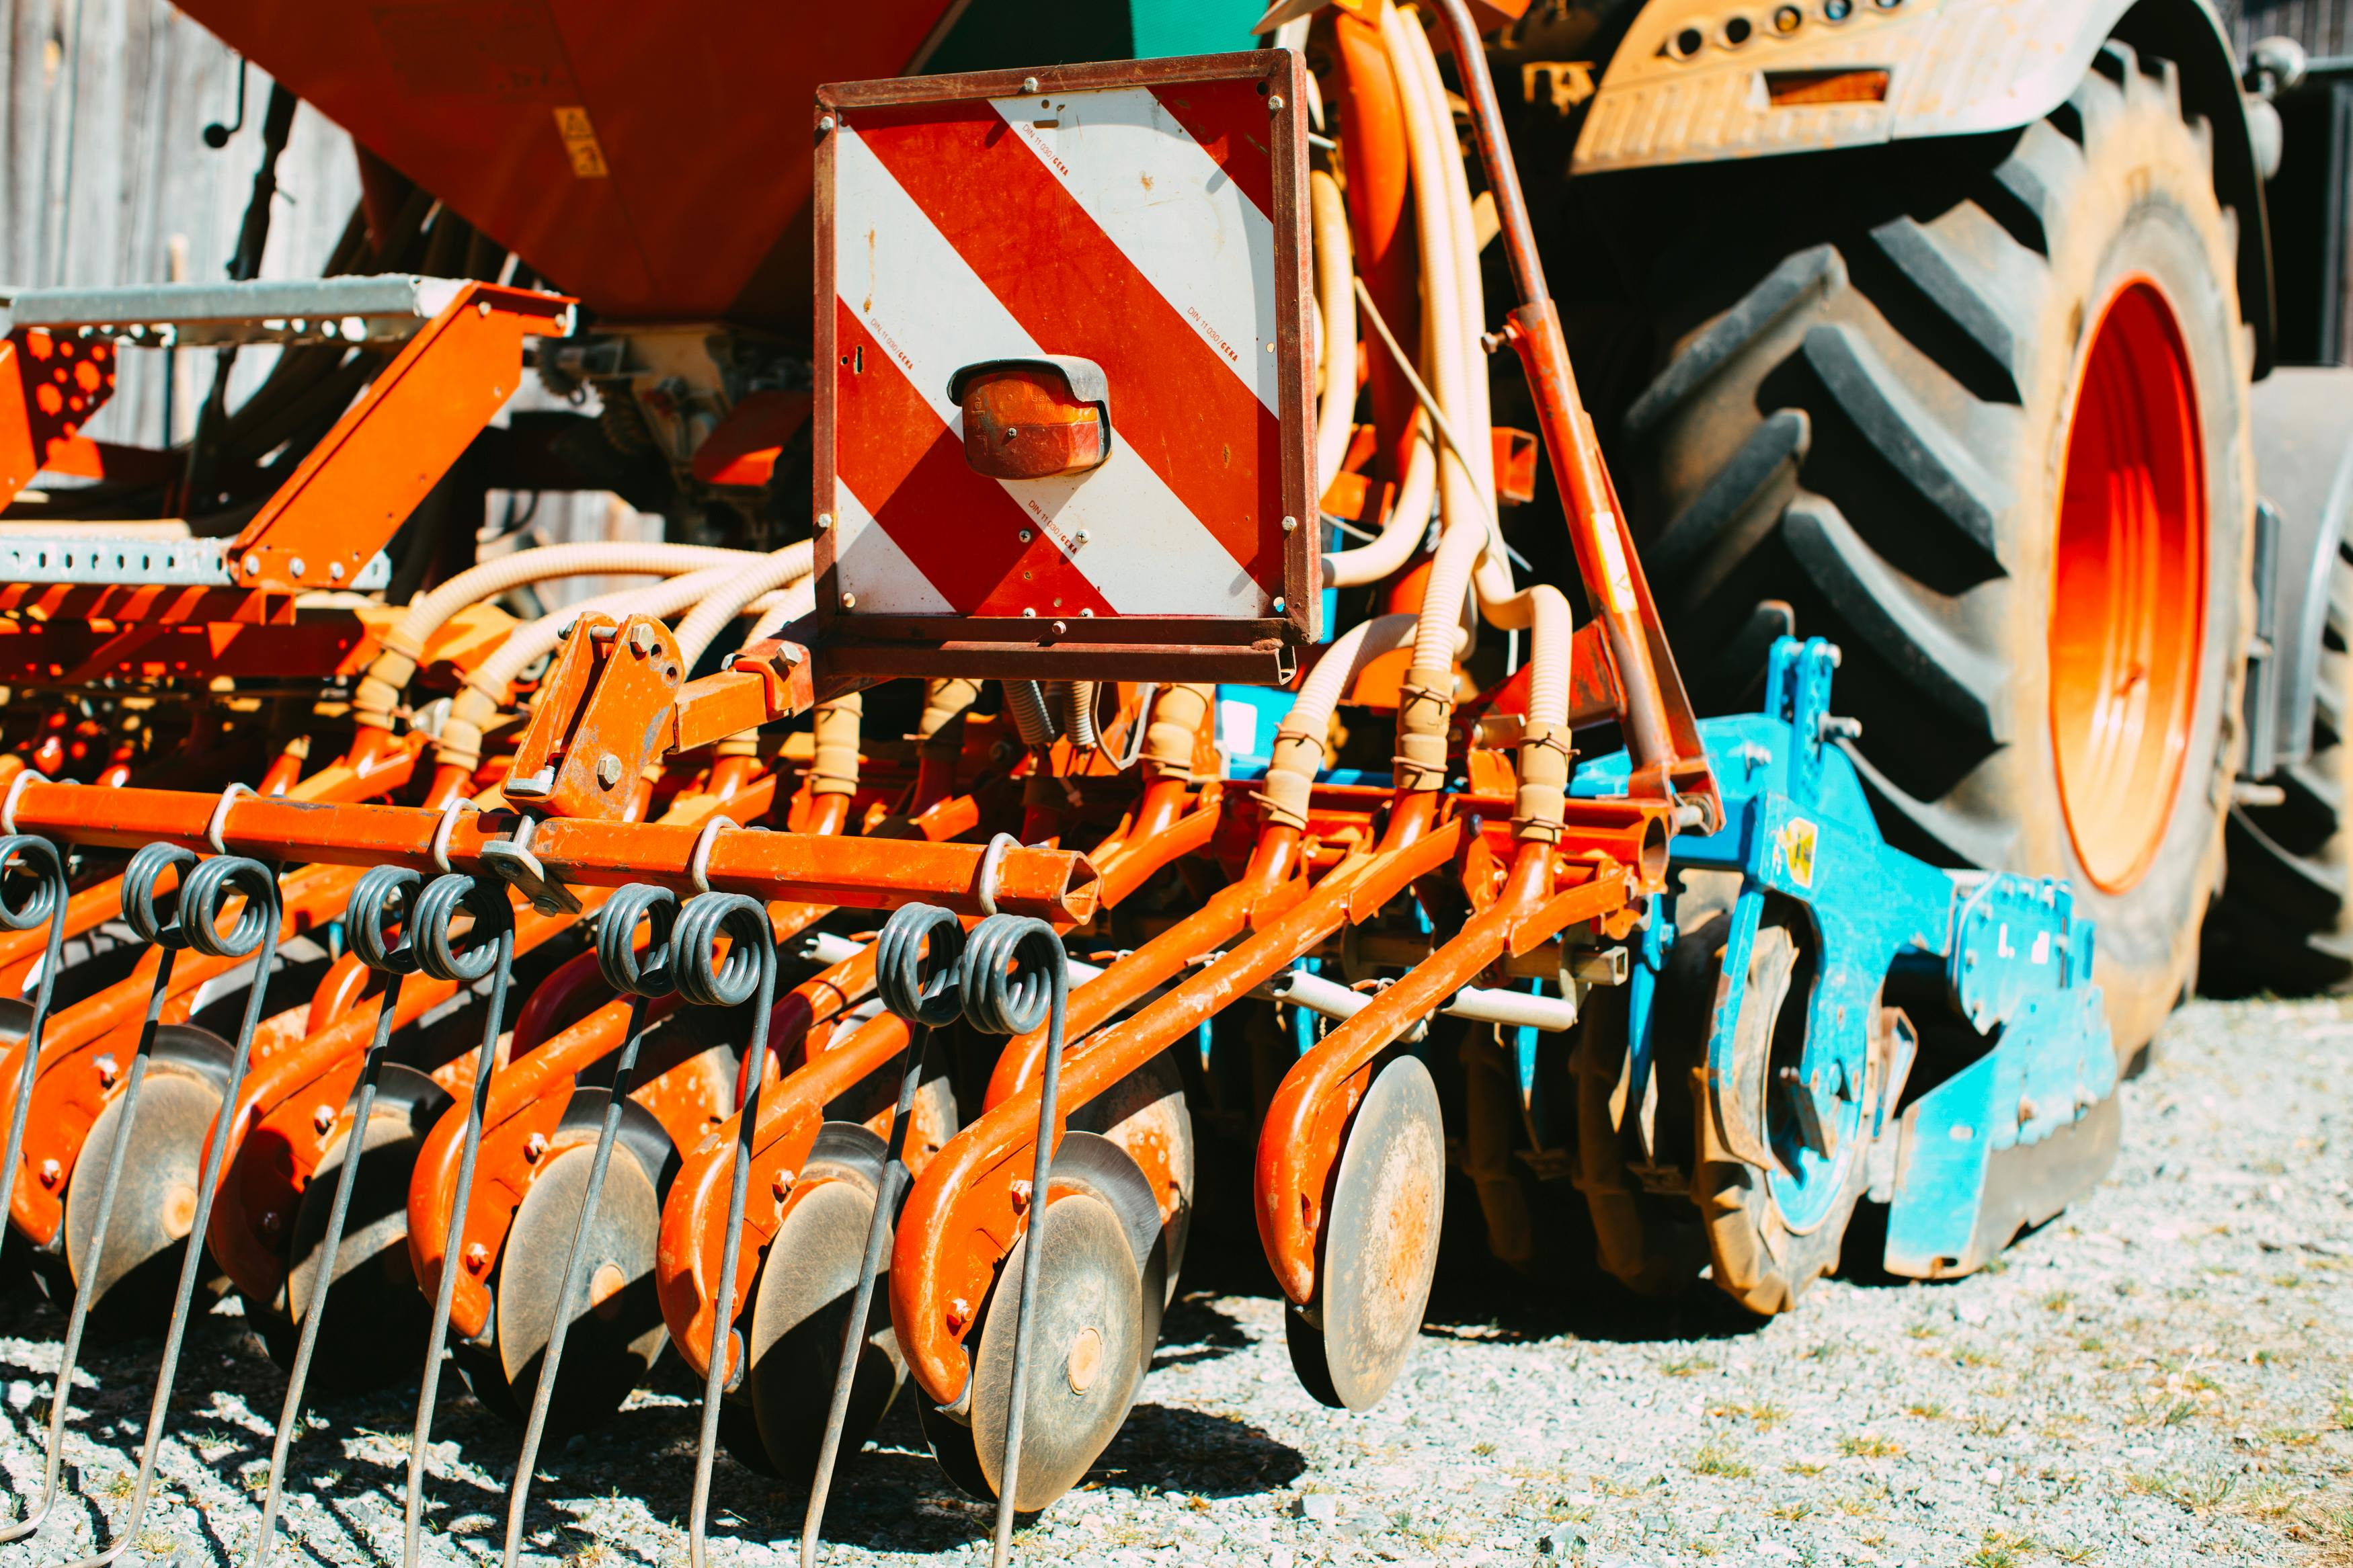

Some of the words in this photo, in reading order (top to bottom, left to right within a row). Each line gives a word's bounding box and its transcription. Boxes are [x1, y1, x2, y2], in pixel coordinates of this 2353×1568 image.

[1023, 124, 1035, 138] DIN
[1187, 306, 1201, 321] DIN
[1029, 500, 1042, 515] DIN
